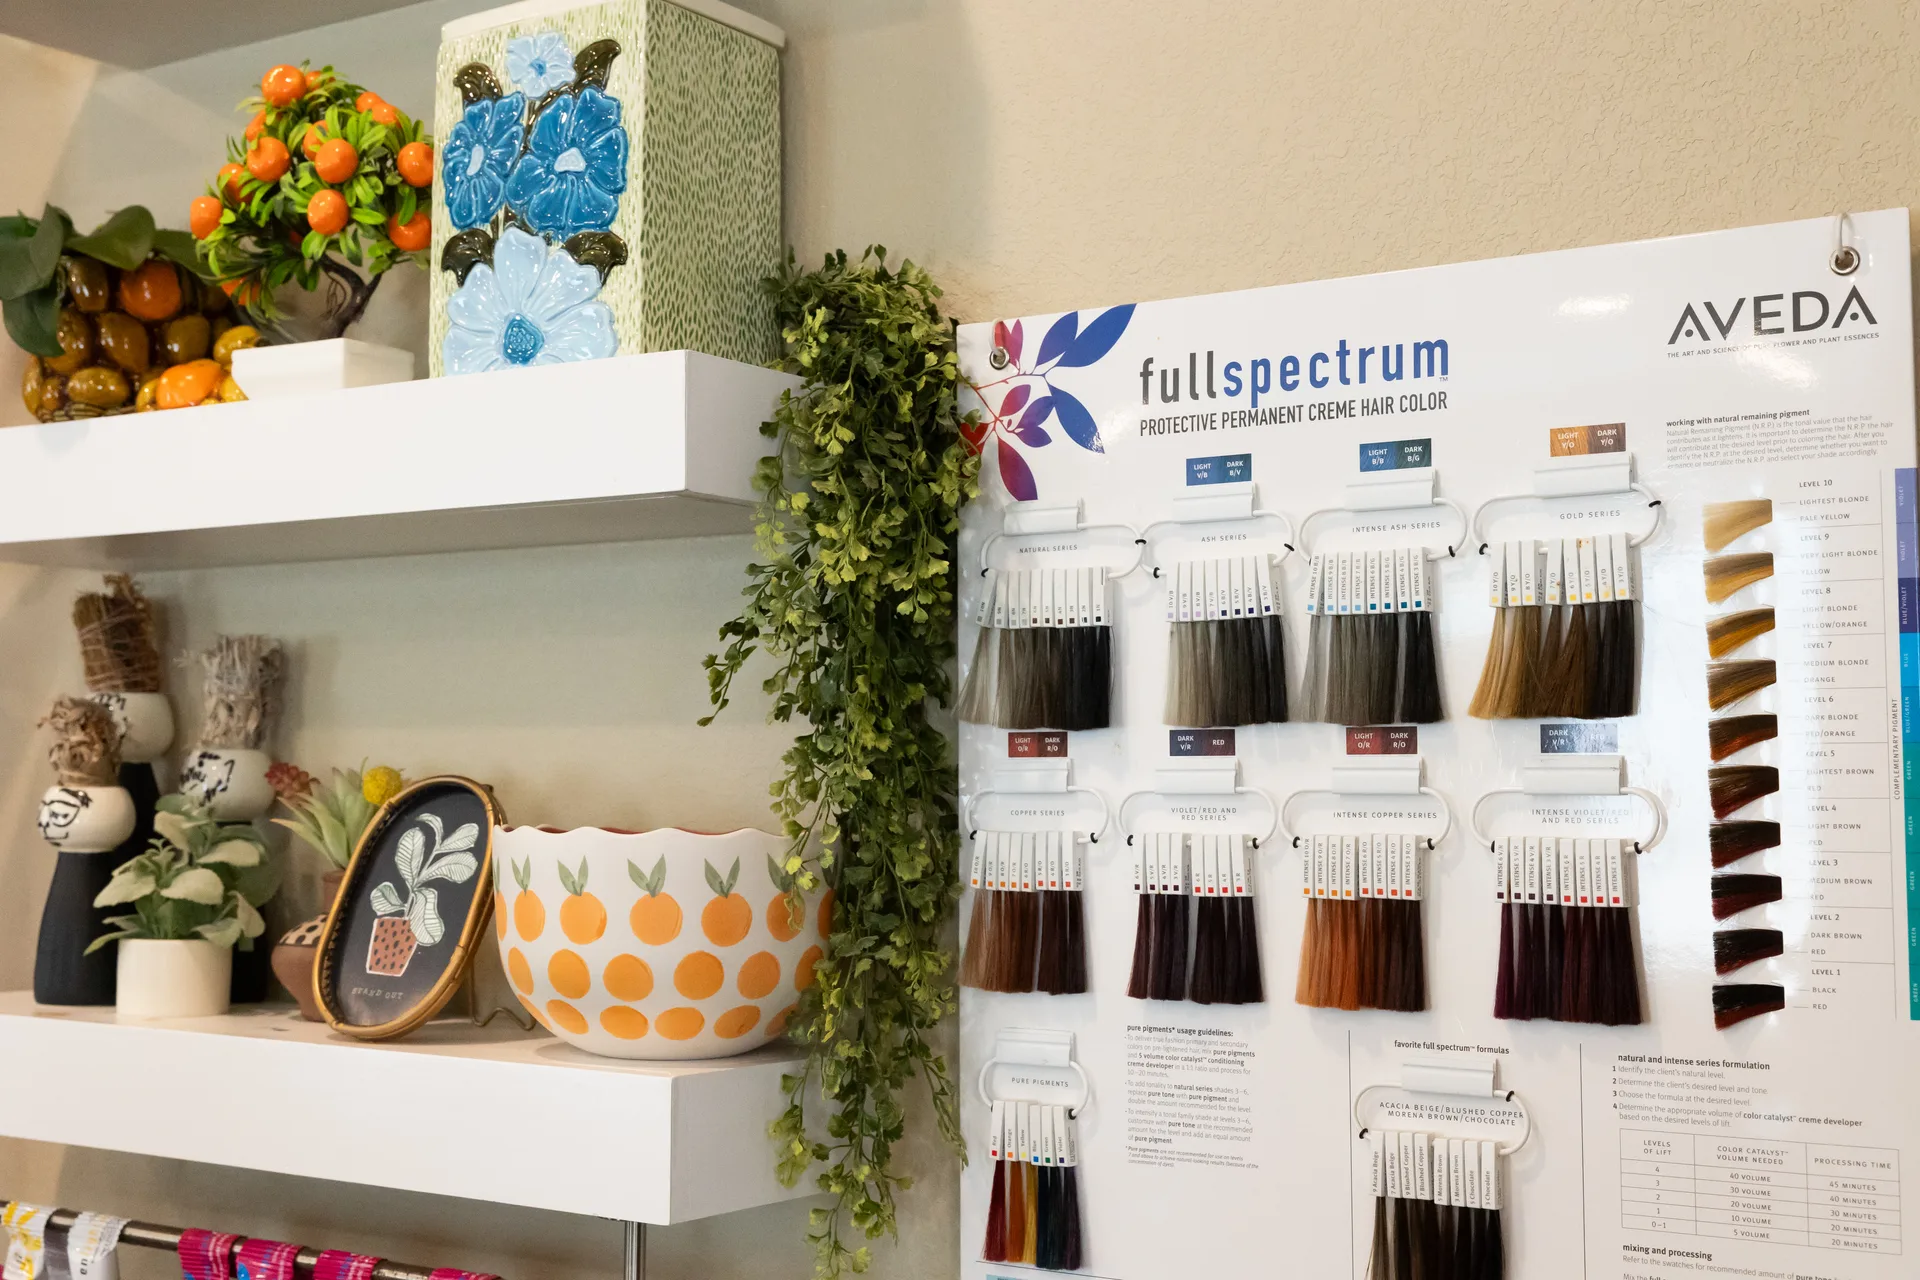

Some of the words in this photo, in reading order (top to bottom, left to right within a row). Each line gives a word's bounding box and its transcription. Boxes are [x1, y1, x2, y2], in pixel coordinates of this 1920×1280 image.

[1668, 285, 1878, 344] AVEDA
[1844, 333, 1879, 341] ESSENCES
[1140, 413, 1217, 436] PROTECTIVE
[1222, 405, 1304, 430] PERMANENT
[1308, 400, 1356, 420] CREME
[1362, 396, 1394, 416] HAIR
[1400, 391, 1447, 413] COLOR
[1741, 412, 1777, 420] remaining
[1780, 410, 1810, 419] pigment
[1558, 432, 1579, 440] LIGHT
[1597, 428, 1617, 436] DARK
[1601, 437, 1614, 446] Y/O
[1368, 448, 1388, 456] LIGHT
[1405, 446, 1422, 454] DARK
[1372, 457, 1384, 466] B/B
[1408, 454, 1420, 463] B/G
[1230, 469, 1241, 477] B/V
[1560, 512, 1584, 520] GOLD
[1589, 510, 1621, 518] SERIES
[1352, 524, 1387, 533] INTENSE
[1411, 521, 1441, 529] SERIES
[1358, 740, 1371, 749] O/R
[1393, 740, 1406, 749] R/O
[1171, 806, 1217, 815] VIOLET/RED
[352, 988, 382, 996] STAND
[1198, 1028, 1233, 1037] guidelines:
[1394, 1040, 1421, 1049] favorite
[1423, 1042, 1435, 1050] full
[1476, 1044, 1509, 1054] formulas
[1618, 1054, 1646, 1063] natural
[1648, 1055, 1662, 1064] and
[1664, 1056, 1694, 1065] intense
[1696, 1059, 1720, 1067] series
[1722, 1059, 1770, 1070] formulation
[1033, 1079, 1069, 1088] PIGMENTS
[1414, 1105, 1485, 1116] BEIGE/BLUSHED
[1490, 1110, 1524, 1118] COPPER
[1388, 1111, 1423, 1119] MORENA
[1428, 1113, 1516, 1126] BROWN/CHOCOLATE
[1744, 1111, 1762, 1119] color
[1823, 1117, 1862, 1127] developer
[1716, 1155, 1749, 1163] VOLUME
[1814, 1158, 1867, 1168] PROCESSING
[1842, 1183, 1876, 1191] MINUTES
[1742, 1188, 1771, 1196] VOLUME
[1842, 1197, 1877, 1206] MINUTES
[1742, 1203, 1772, 1211] VOLUME
[1742, 1216, 1772, 1225] VOLUME
[1842, 1212, 1877, 1220] MINUTES
[1740, 1230, 1770, 1239] VOLUME
[1843, 1226, 1877, 1235] MINUTES
[1844, 1241, 1878, 1249] MINUTES
[1622, 1244, 1650, 1253] mixing
[1668, 1249, 1712, 1260] processing
